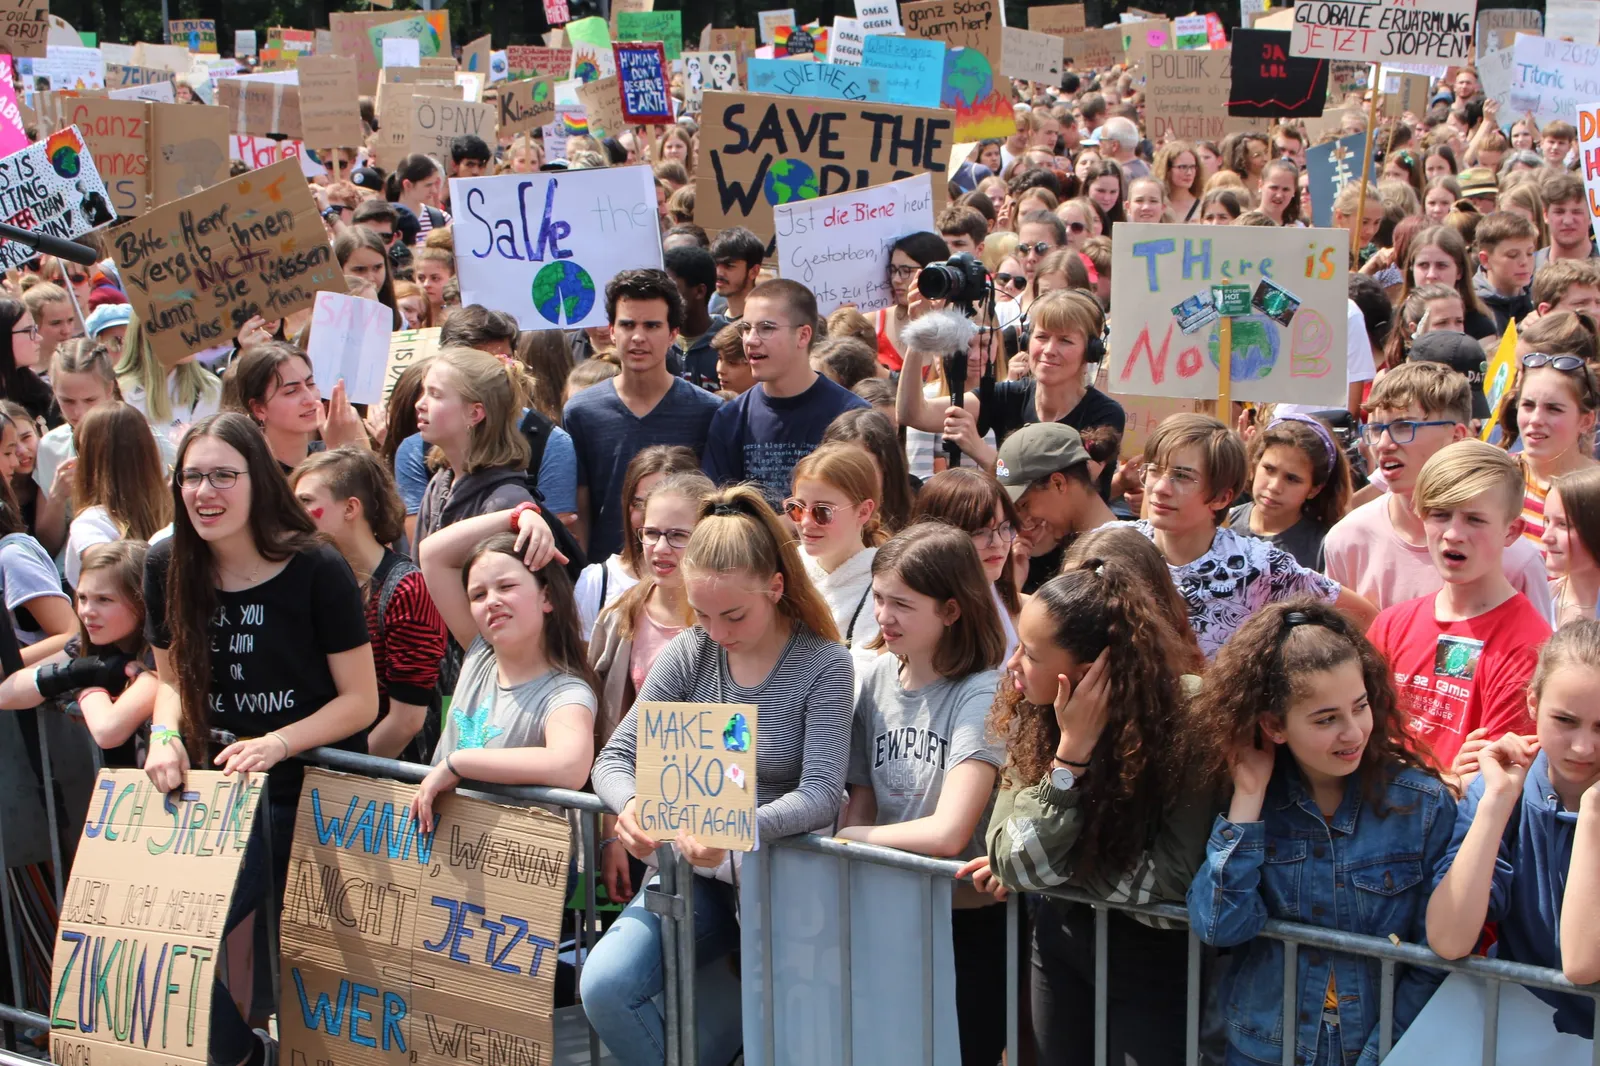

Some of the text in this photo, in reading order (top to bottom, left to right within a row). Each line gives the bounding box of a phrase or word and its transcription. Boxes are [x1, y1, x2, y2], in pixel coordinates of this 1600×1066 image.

[862, 6, 889, 16] OMAS
[863, 19, 892, 29] GEGEN
[908, 5, 945, 31] ganz
[920, 11, 993, 38] warm hier!
[1295, 4, 1373, 29] GLOBALE
[1378, 7, 1470, 33] ERWÄRMUNG
[5, 23, 48, 43] BRO!
[1298, 24, 1473, 58] JETZT STOPPEN!
[620, 52, 660, 68] HUMANS
[1262, 43, 1286, 61] JA
[623, 77, 663, 94] DESERVE
[774, 63, 813, 94] LOVE
[817, 63, 846, 90] THE
[1260, 63, 1288, 78] LOL
[627, 91, 668, 113] EARTH
[73, 105, 143, 139] Ganz
[418, 100, 486, 135] ÖPNV
[723, 102, 951, 172] SAVE THE
[14, 154, 36, 181] IS
[31, 192, 65, 221] THAN
[590, 193, 650, 233] the
[823, 206, 850, 228] die
[851, 202, 896, 222] Biene
[193, 247, 270, 292] NICHT
[1304, 241, 1337, 281] is
[841, 286, 862, 299] zu
[1119, 322, 1204, 386] No
[1290, 308, 1334, 379] B
[240, 604, 264, 625] YOU
[229, 632, 254, 654] WITH
[230, 662, 245, 681] OR
[645, 709, 714, 751] MAKE
[660, 753, 725, 805] ÖKO
[147, 777, 262, 858] STREIKE
[641, 800, 754, 842] GREAT AGAIN
[311, 787, 564, 888] WANN, WENN
[66, 877, 226, 939] WEIL ICH MEINE
[290, 859, 556, 978] NICHT JETZT
[51, 930, 214, 1050] ZUKUNFT
[425, 1013, 541, 1066] WENN
